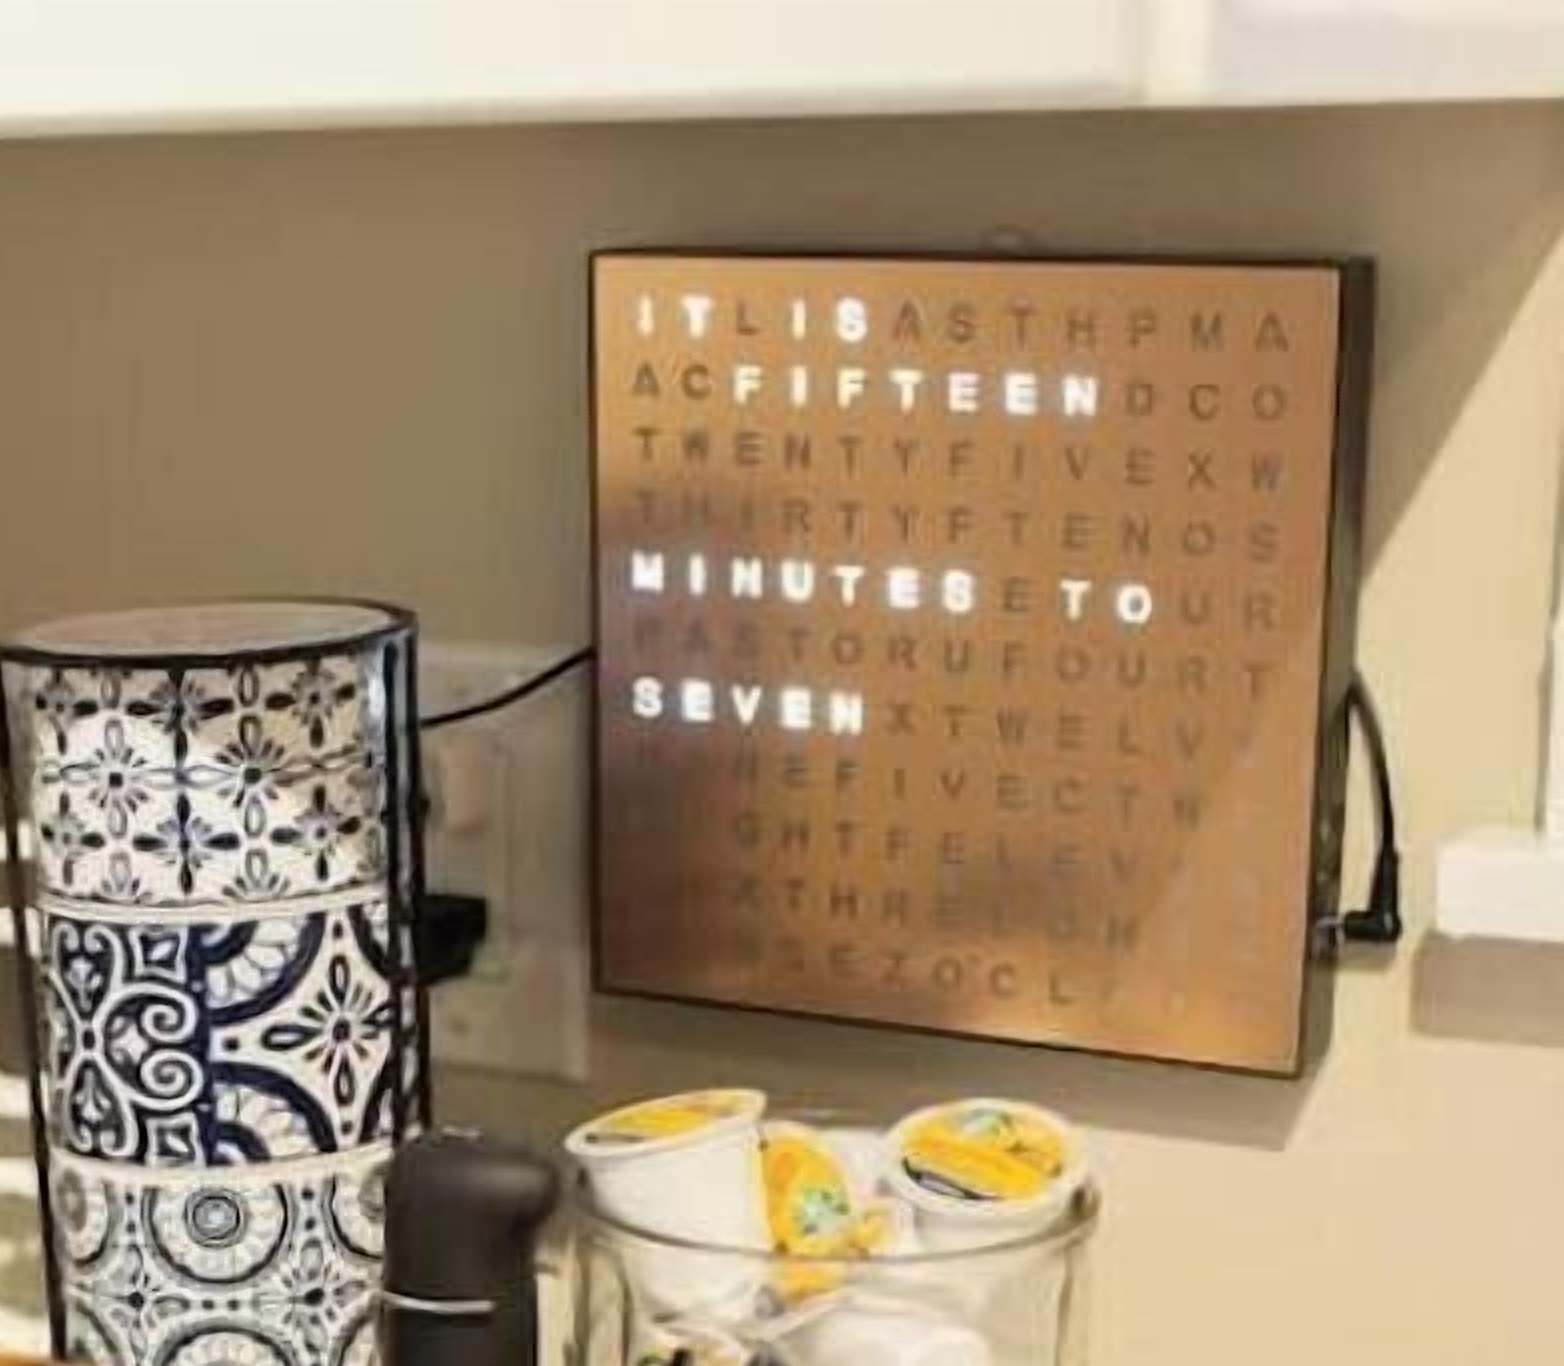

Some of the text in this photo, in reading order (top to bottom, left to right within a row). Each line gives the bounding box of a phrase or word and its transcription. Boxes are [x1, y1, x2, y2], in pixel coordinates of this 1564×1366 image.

[733, 364, 1100, 418] FIFTEEN
[631, 551, 975, 613] MINUTES
[1059, 578, 1154, 625] TO
[632, 676, 864, 736] SEVEN
